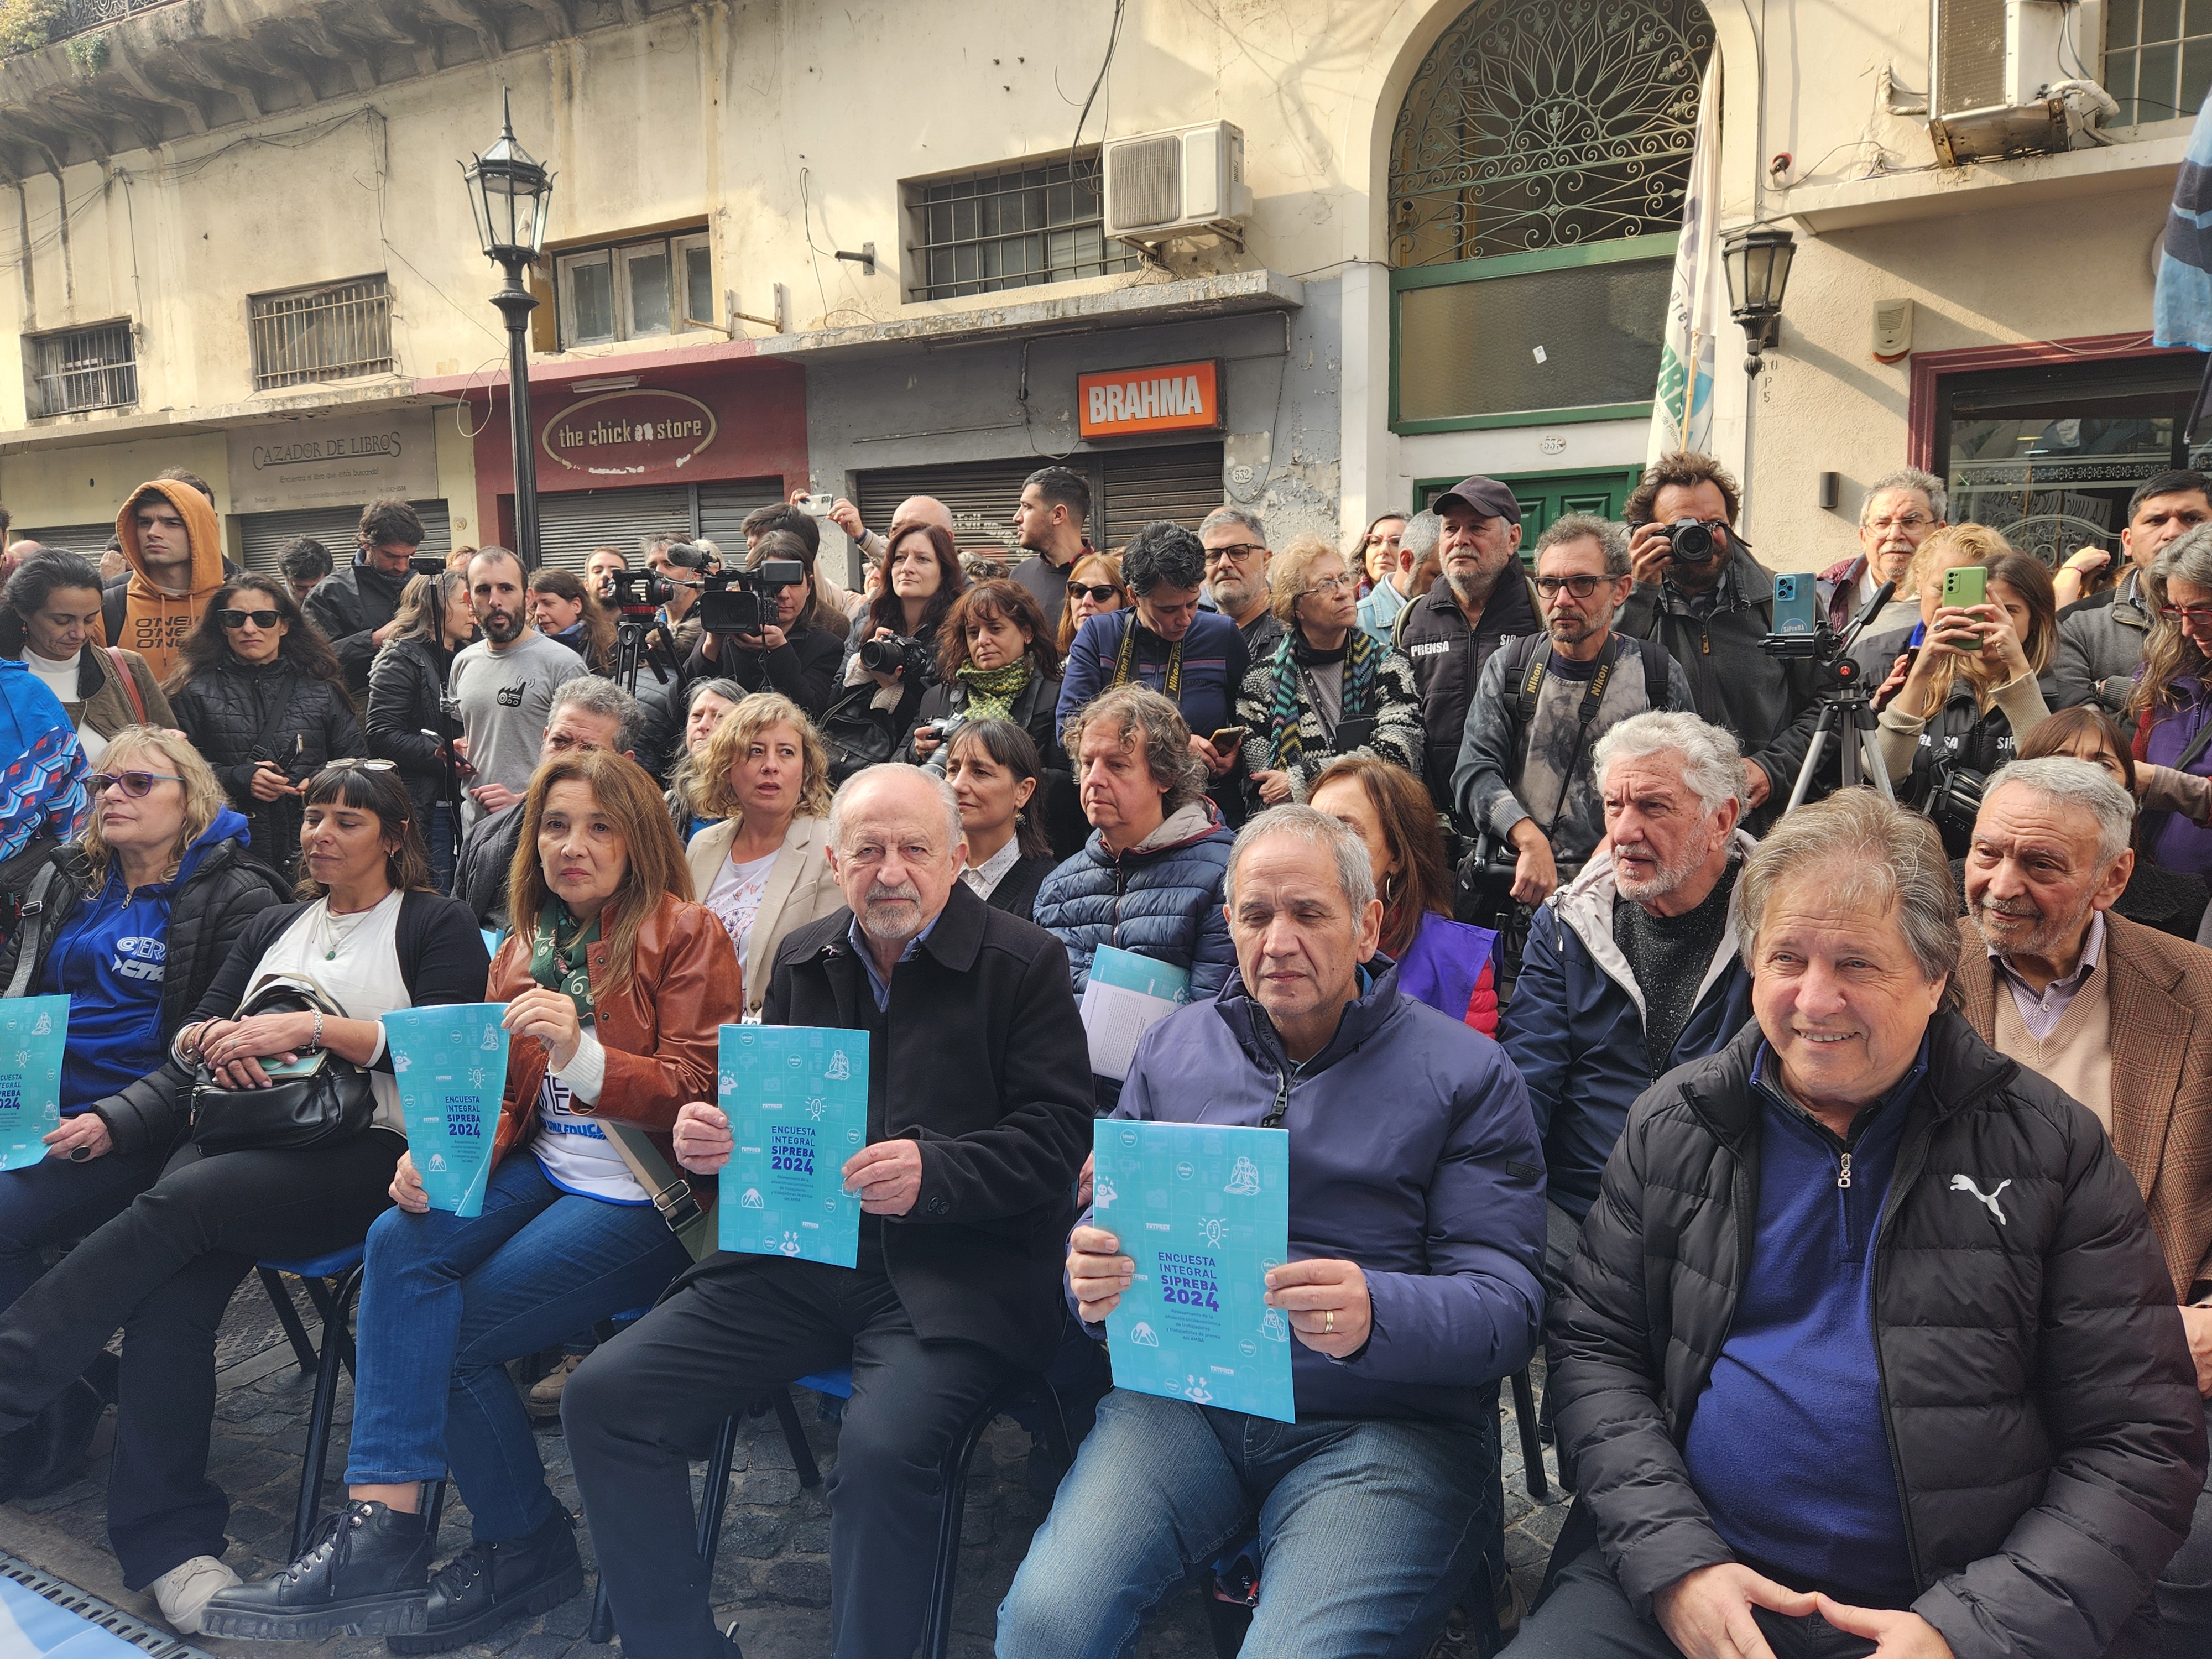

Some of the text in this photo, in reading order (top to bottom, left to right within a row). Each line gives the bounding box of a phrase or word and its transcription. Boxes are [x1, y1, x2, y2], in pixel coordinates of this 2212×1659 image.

[1089, 375, 1203, 424] BRAHMA
[559, 424, 585, 448] the
[656, 419, 702, 440] store
[252, 431, 402, 471] CAZADOR DE LIBROS
[1235, 469, 1249, 481] 532
[1411, 640, 1450, 658] PRENSA
[1168, 662, 1180, 691] Nikon
[1526, 662, 1543, 694] Nikon
[1590, 664, 1609, 697] Nikon
[1252, 1005, 1275, 1048] ROCHAS
[445, 1095, 480, 1104] ENCUESTA
[447, 1114, 481, 1123] SIPREBA
[546, 1119, 562, 1133] UNA
[448, 1123, 481, 1139] 2024
[771, 1126, 816, 1136] ENCUESTA
[771, 1135, 816, 1147] INTEGRAL
[771, 1145, 815, 1159] SIPREBA
[771, 1156, 814, 1176] 2024
[1158, 1251, 1217, 1267] ENCUESTA
[1159, 1263, 1217, 1279] INTEGRAL
[1161, 1274, 1219, 1292] SIPREBA
[1163, 1286, 1220, 1312] 2024
[1171, 1308, 1202, 1318] Relevamiento
[1181, 1323, 1211, 1332] trabajadores
[1185, 1317, 1221, 1327] socioeconómica
[1169, 1327, 1198, 1337] trabajadoras
